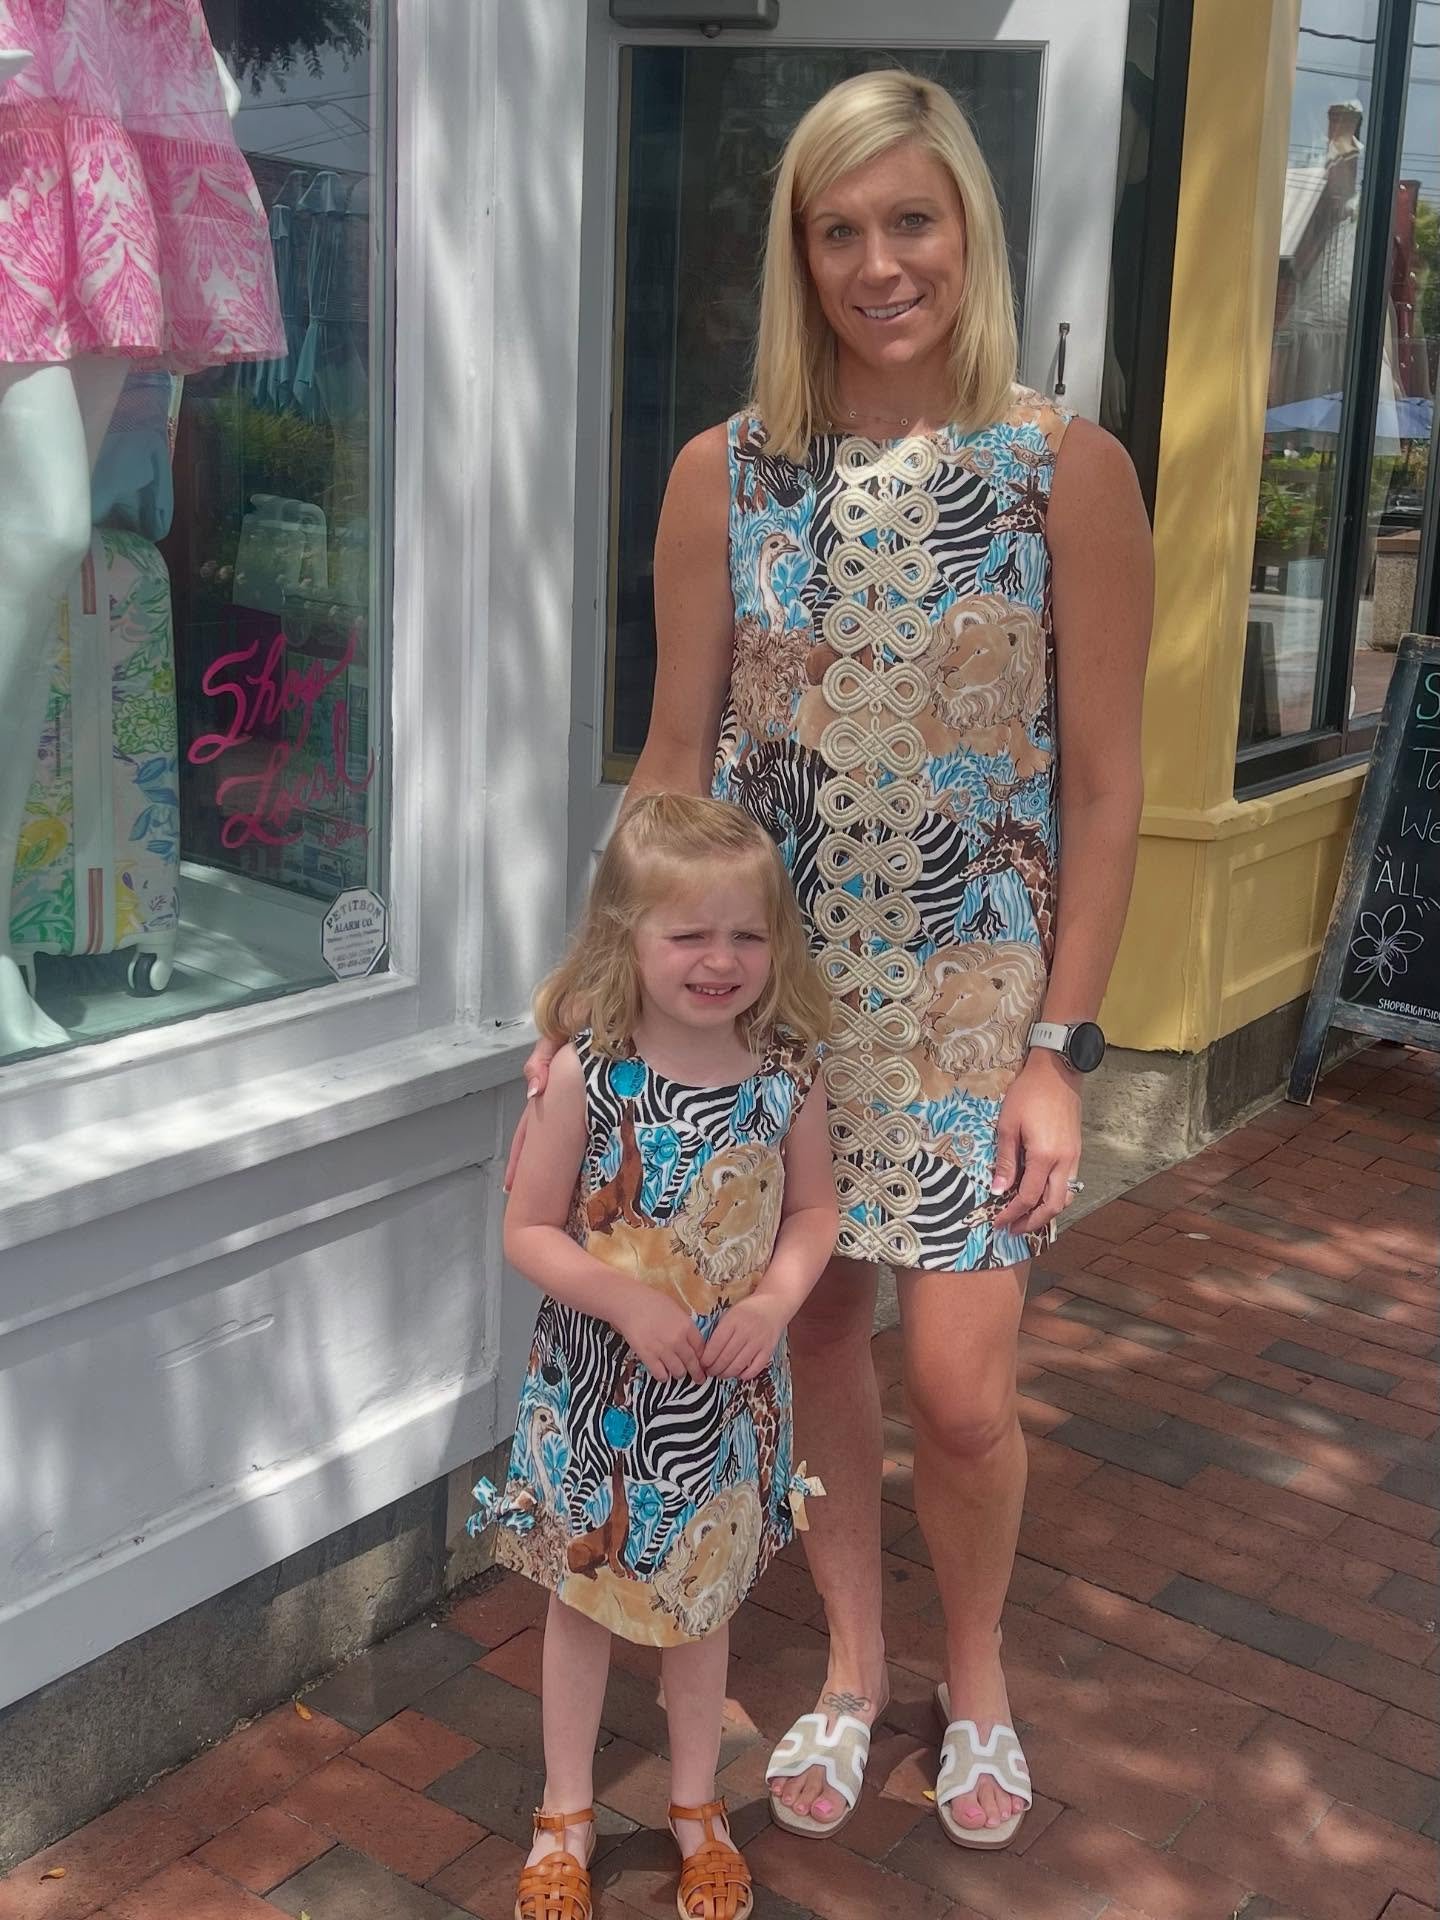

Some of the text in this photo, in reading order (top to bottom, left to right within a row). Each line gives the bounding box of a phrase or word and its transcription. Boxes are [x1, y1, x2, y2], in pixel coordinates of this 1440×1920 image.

[187, 625, 359, 765] Shop
[215, 699, 376, 849] Local
[1374, 860, 1424, 899] ALL
[335, 920, 360, 933] ALARM
